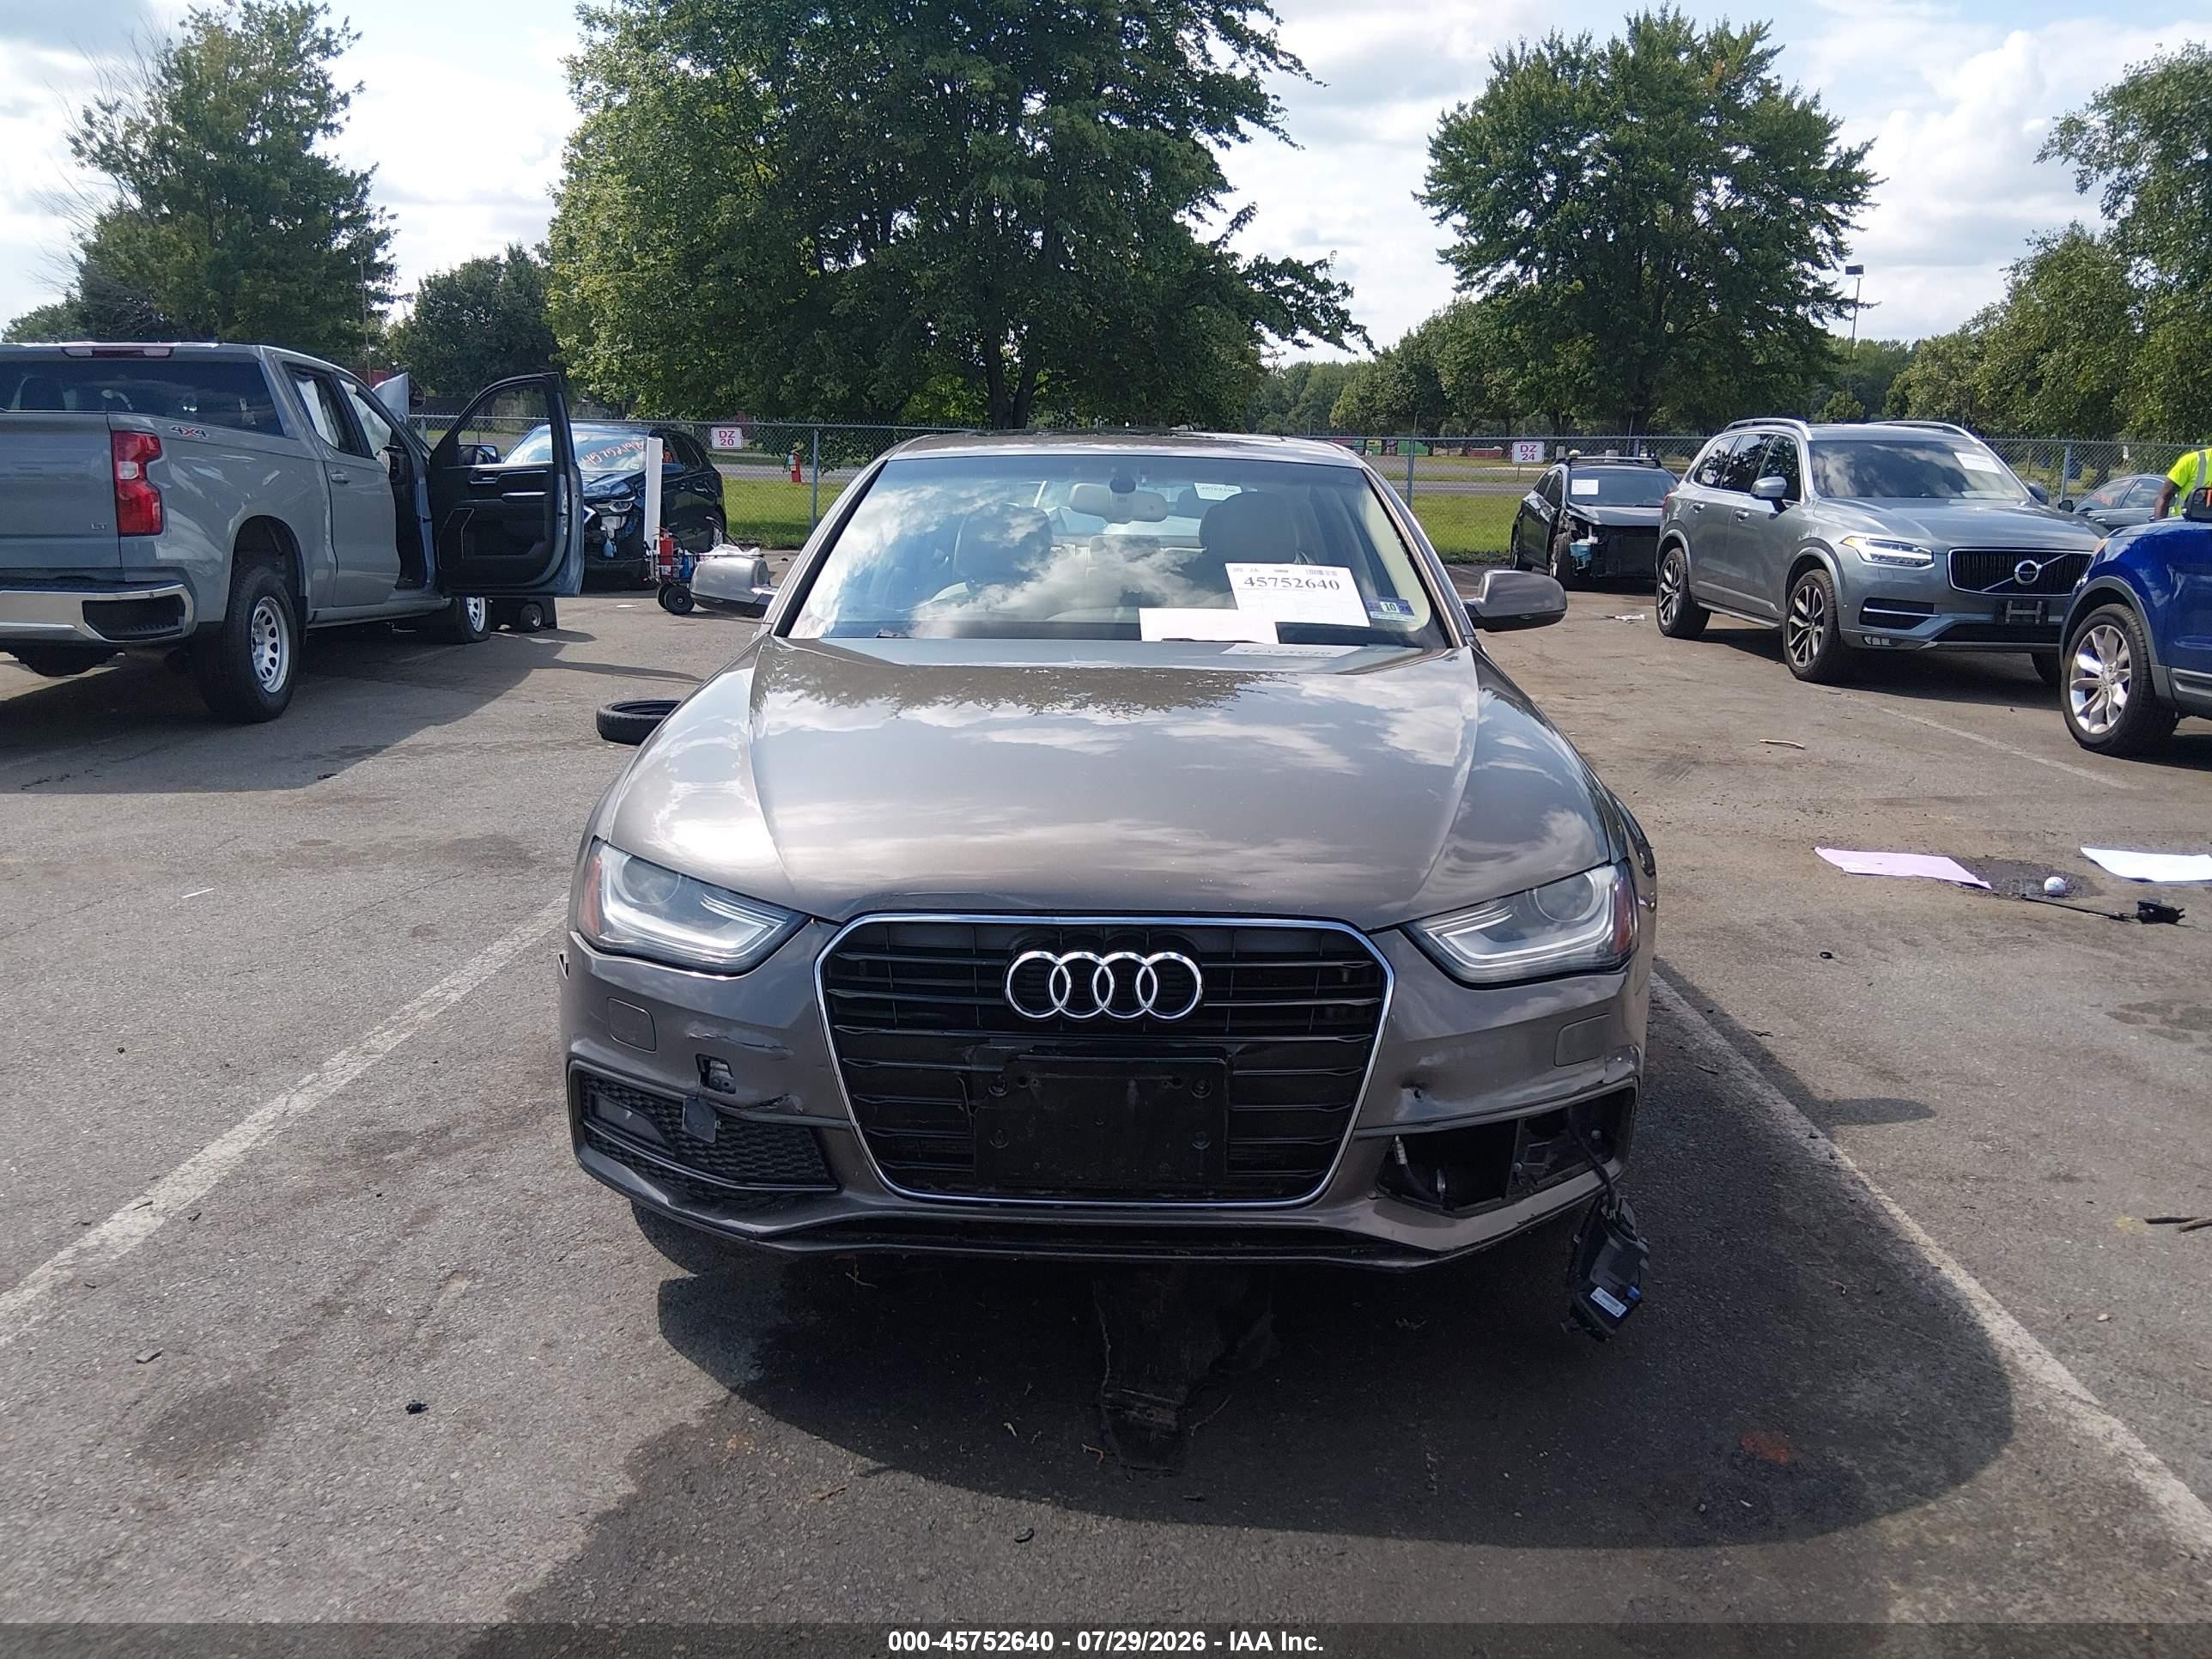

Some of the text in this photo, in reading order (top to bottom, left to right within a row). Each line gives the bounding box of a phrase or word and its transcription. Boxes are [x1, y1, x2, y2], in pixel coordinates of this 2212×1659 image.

[720, 438, 734, 447] 20
[1243, 576, 1340, 591] 45752640
[1383, 603, 1397, 611] 10
